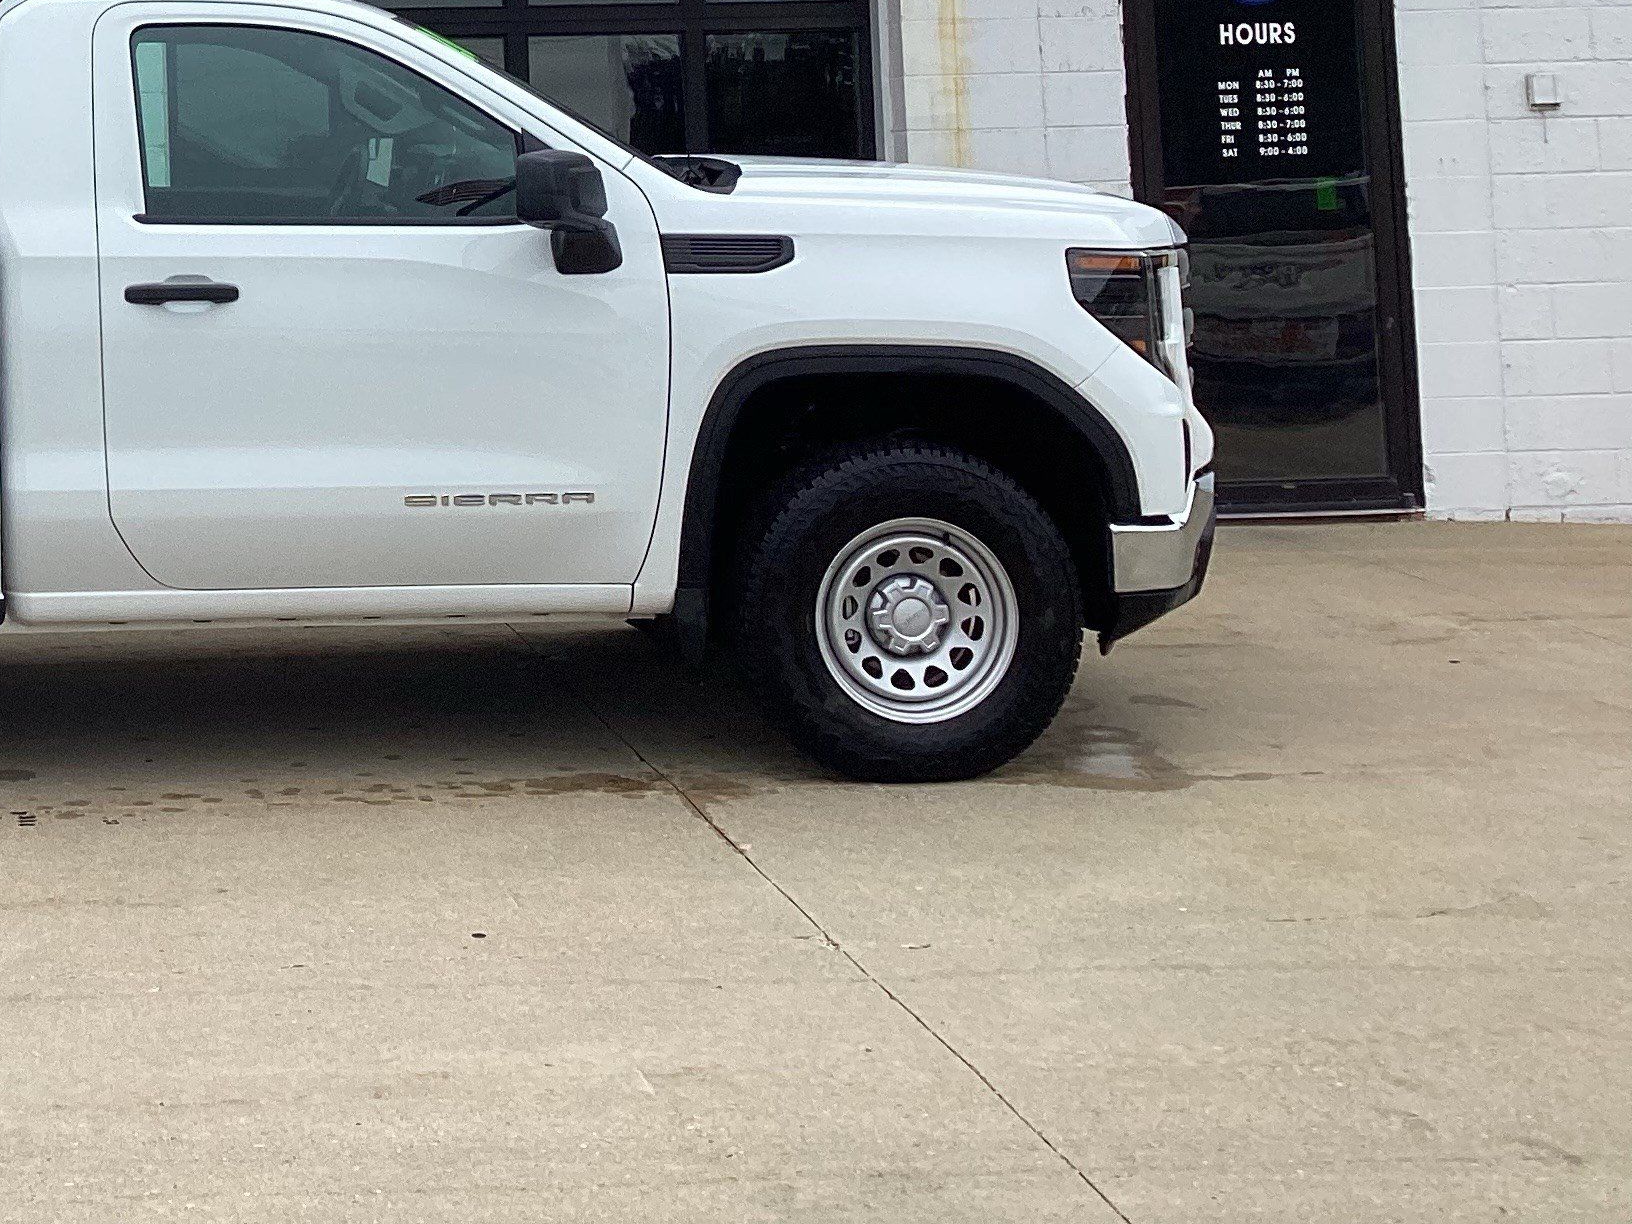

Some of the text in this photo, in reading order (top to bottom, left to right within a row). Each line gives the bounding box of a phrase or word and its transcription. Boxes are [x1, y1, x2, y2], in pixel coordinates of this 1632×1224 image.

[1218, 22, 1296, 45] HOURS
[1257, 67, 1300, 78] AM PM
[1217, 81, 1240, 90] MON
[1218, 94, 1239, 104] TUES
[1219, 108, 1240, 117] WED
[1220, 121, 1242, 131] THUR
[1220, 134, 1235, 144] FRI
[1222, 147, 1238, 158] SAT
[403, 491, 596, 508] SIERRA
